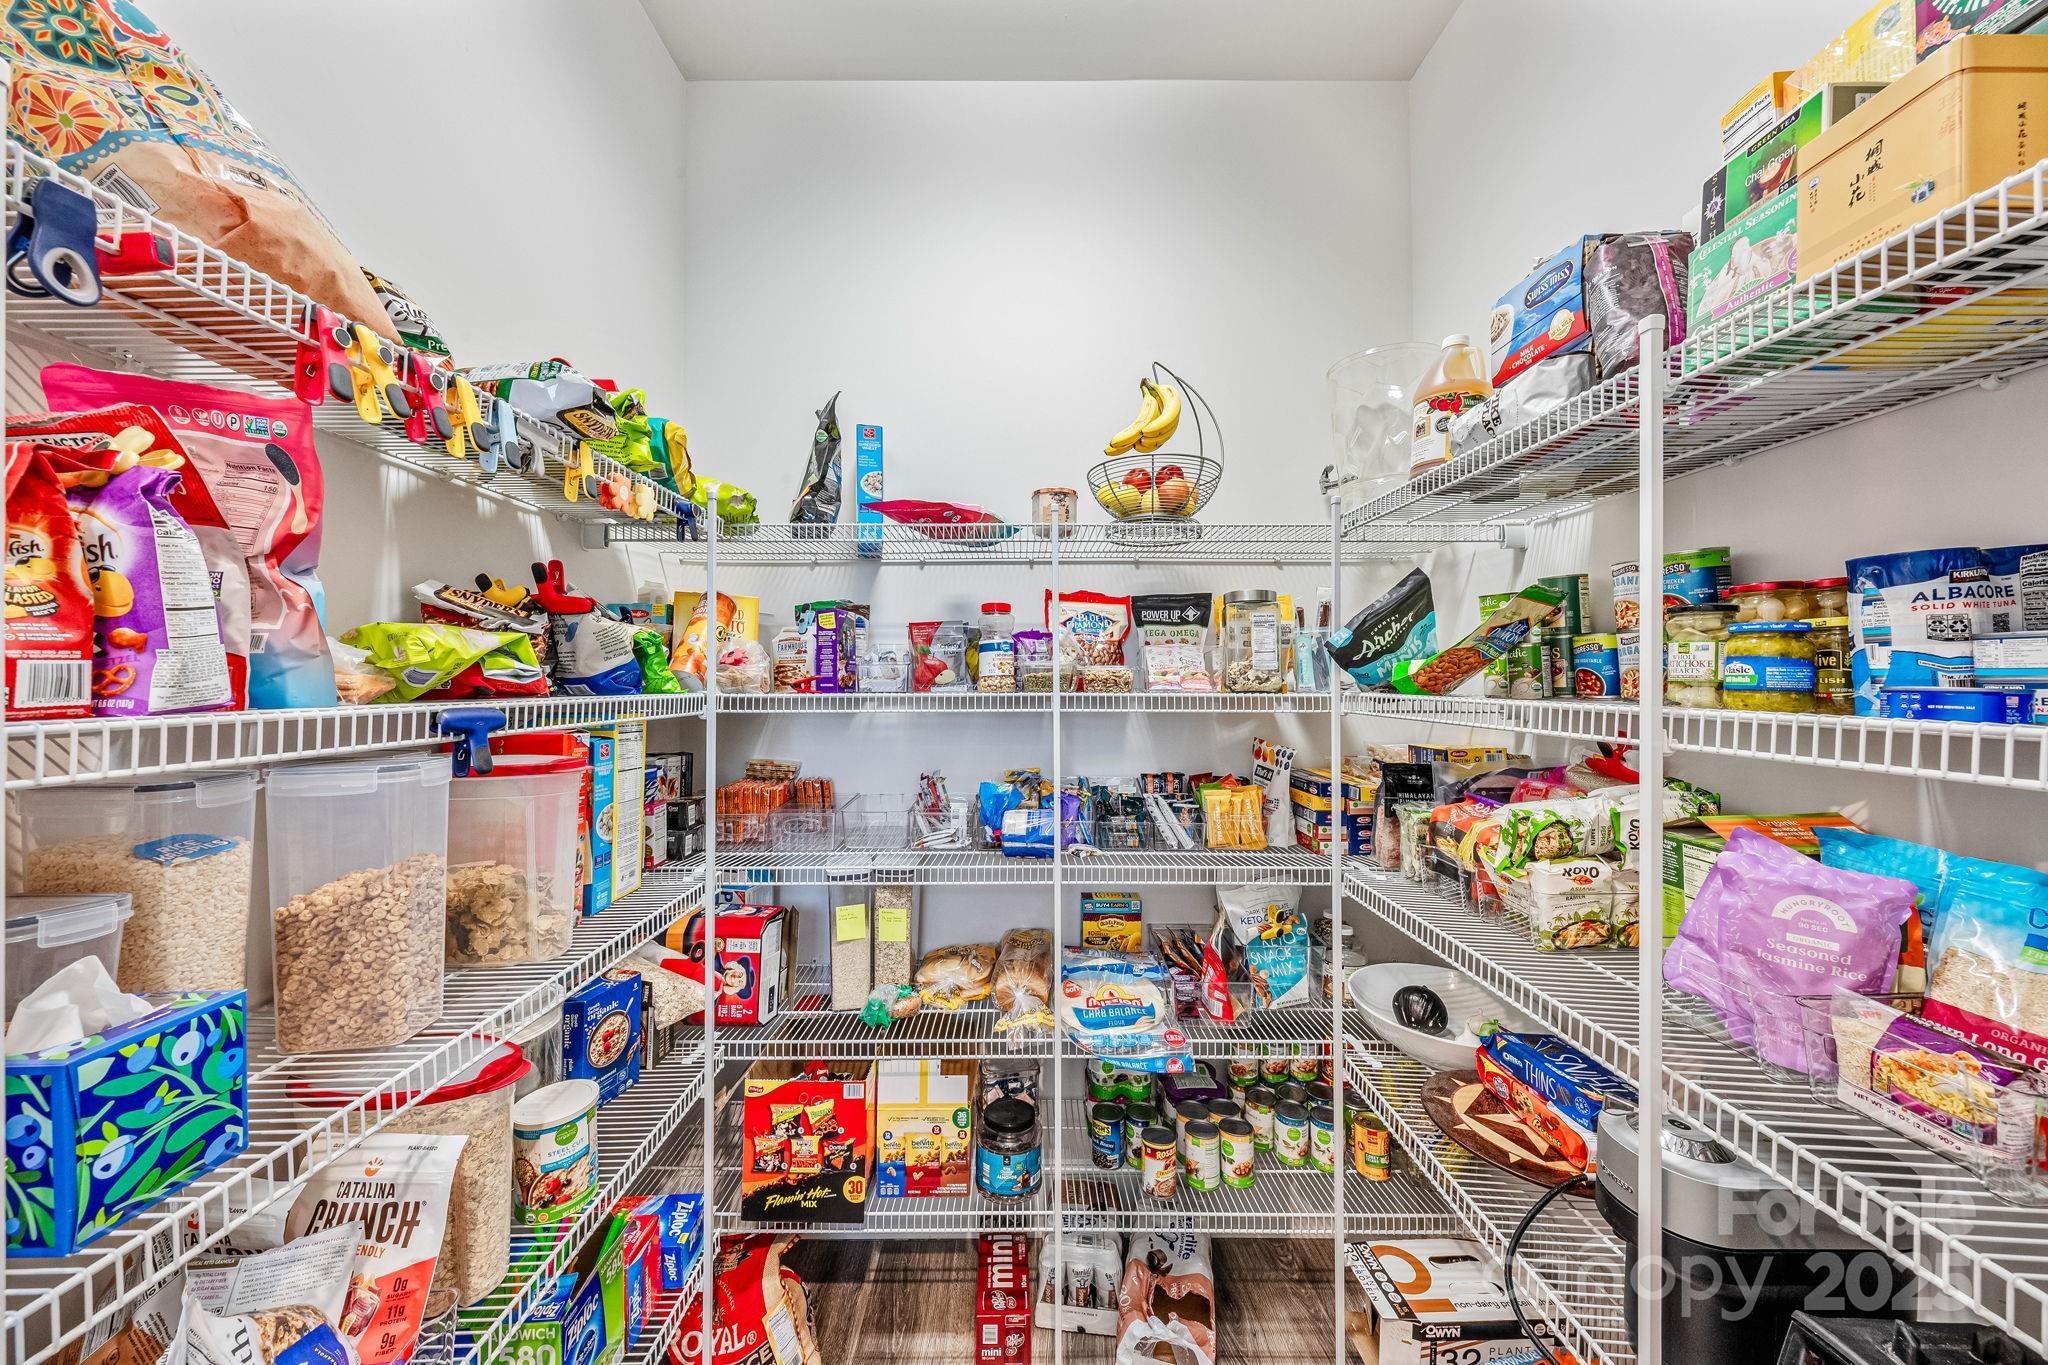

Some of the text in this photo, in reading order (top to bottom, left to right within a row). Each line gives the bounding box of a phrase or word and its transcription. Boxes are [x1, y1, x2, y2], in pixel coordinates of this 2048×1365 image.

[1722, 93, 1772, 136] Supplement Facts
[1751, 116, 1797, 153] GREEN TEA
[1744, 144, 1797, 188] Chai Green
[1699, 192, 1797, 261] CELESTIAL SEASONIN
[1526, 264, 1571, 305] SWISS MISS
[1726, 280, 1774, 312] Authentic
[1511, 344, 1545, 370] CHOCOLATE
[1519, 343, 1535, 359] MILK
[264, 485, 277, 494] 150
[2022, 580, 2048, 588] Calorie
[5, 590, 55, 605] LASTED
[1911, 584, 2015, 604] ALBACORE
[1911, 600, 2017, 612] SOLID WHITE TUNA
[1077, 614, 1101, 623] BLUE
[1142, 610, 1181, 620] POWER UP
[1066, 620, 1112, 630] DIAMOND
[1370, 614, 1399, 636] COUNTRY
[1169, 630, 1200, 638] OMEGA
[1353, 611, 1414, 661] Archer
[777, 641, 808, 652] FARMHOUSE
[1669, 660, 1713, 668] RTICHOKE
[107, 699, 115, 708] OZ
[1562, 866, 1600, 879] KOYO
[1240, 915, 1262, 925] KETO
[1246, 909, 1260, 917] DARK
[1779, 897, 1850, 929] HUNGRYROOT
[1810, 924, 1829, 933] SEC
[1250, 947, 1292, 966] SNACK
[1766, 937, 1852, 966] Seasoned
[1270, 961, 1297, 978] MIX
[1757, 948, 1867, 982] Jasmine Rice
[587, 1000, 619, 1022] organic
[1082, 1007, 1148, 1019] CARB BALANCE
[563, 1014, 572, 1049] organic
[1991, 1028, 2048, 1057] ORGANI
[1124, 1061, 1148, 1070] BALANCE
[1502, 1051, 1523, 1068] OREO
[1524, 1058, 1558, 1102] THINS
[1853, 1091, 1870, 1102] NET
[547, 1137, 585, 1158] STEEL CUT
[883, 1140, 901, 1148] belVita
[911, 1138, 934, 1146] belVita
[336, 1180, 396, 1199] CATALINA
[847, 1180, 863, 1194] 30
[764, 1185, 832, 1211] Flamin' Hot
[801, 1200, 818, 1208] MIX
[304, 1199, 421, 1249] CRUNCH
[668, 1200, 695, 1237] Ziploc
[308, 1237, 345, 1250] INTENTION
[356, 1244, 385, 1259] ENDLY
[663, 1252, 678, 1283] Ziploc
[987, 1233, 1014, 1289] mini
[392, 1277, 408, 1292] 0g
[386, 1304, 405, 1320] 11g
[1454, 1299, 1500, 1309] non-dairy
[379, 1316, 407, 1327] PROTEIN
[566, 1293, 600, 1351] Ziploc
[490, 1327, 556, 1342] ANDWICH
[1425, 1327, 1461, 1338] OWYN
[380, 1332, 397, 1350] 9g
[500, 1345, 557, 1365] 580
[981, 1347, 1002, 1357] mini
[1489, 1347, 1532, 1356] PLANT
